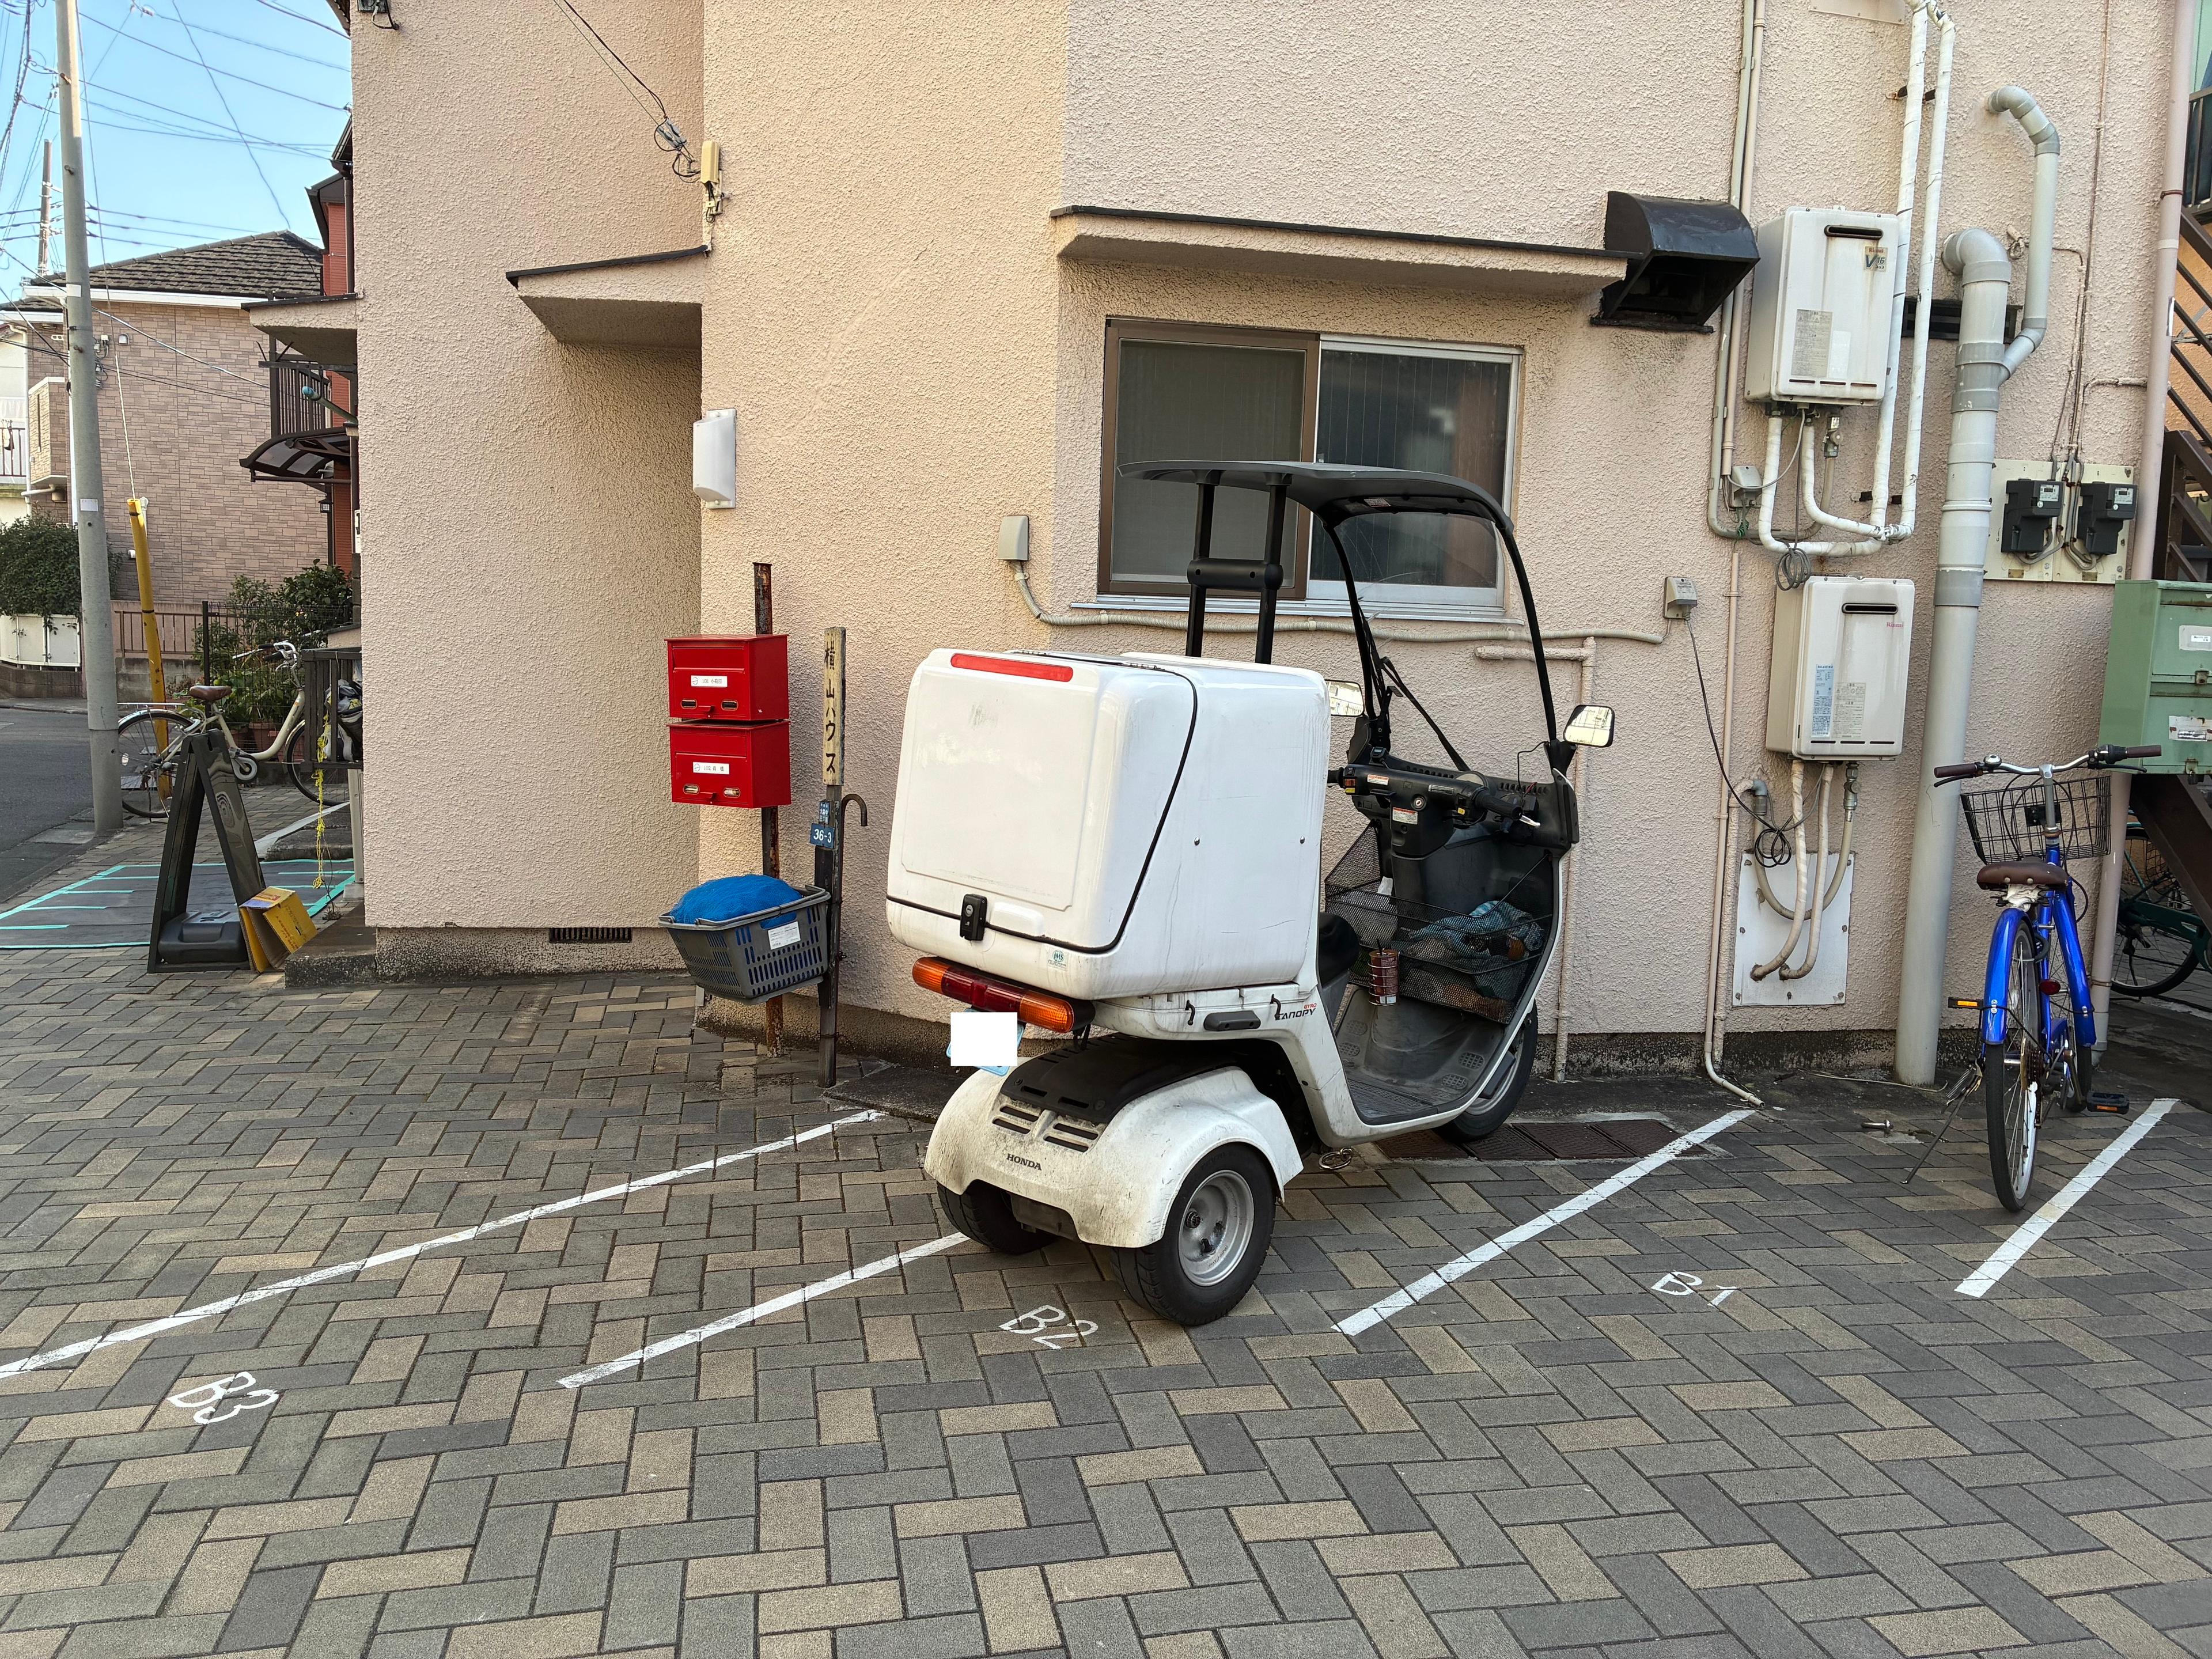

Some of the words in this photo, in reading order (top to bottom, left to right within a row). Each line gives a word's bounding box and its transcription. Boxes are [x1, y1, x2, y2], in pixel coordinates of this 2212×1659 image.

[824, 639, 836, 773] 横山ハウス
[813, 828, 832, 843] 36-3
[1006, 1153, 1041, 1171] HONDA
[1650, 1270, 1738, 1308] B1
[998, 1305, 1099, 1350] B2
[166, 1371, 279, 1425] B3
